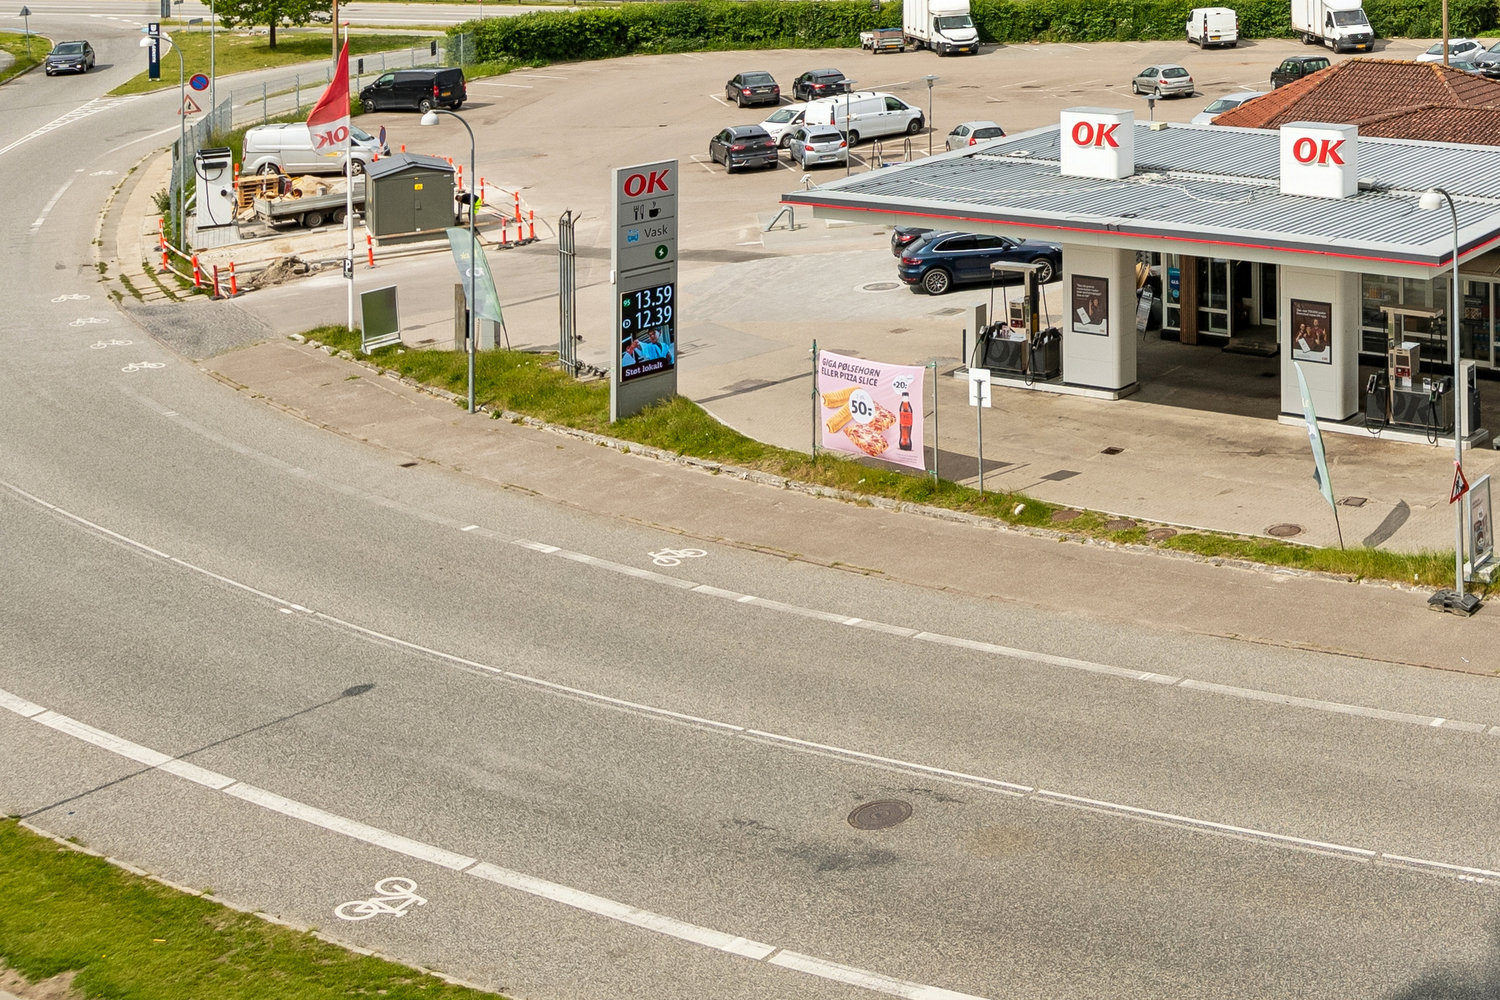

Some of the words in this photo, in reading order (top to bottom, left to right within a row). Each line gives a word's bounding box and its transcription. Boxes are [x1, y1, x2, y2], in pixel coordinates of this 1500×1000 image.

[1071, 121, 1121, 148] OK
[1292, 137, 1346, 165] OK
[623, 168, 671, 198] OK
[644, 224, 668, 239] Vask
[345, 259, 352, 272] P
[635, 285, 673, 310] 13.59
[635, 305, 673, 330] 12.39
[625, 367, 641, 377] Støt
[642, 361, 663, 372] lokalt
[821, 358, 837, 369] GIGA
[837, 360, 881, 378] PØLSEHORN
[821, 367, 839, 379] ELLER
[839, 371, 858, 383] PIZZA
[858, 376, 878, 387] SLICE
